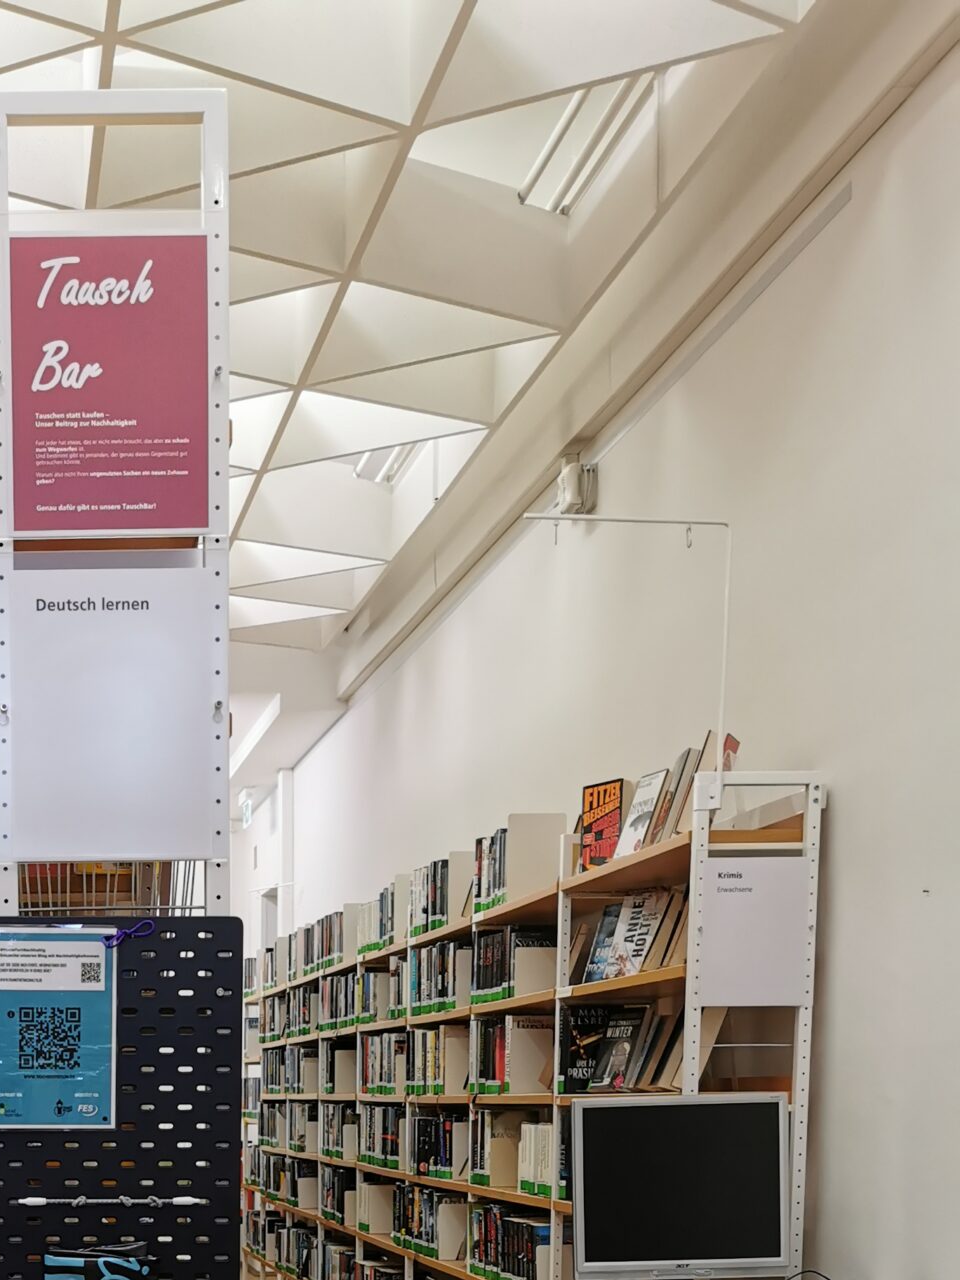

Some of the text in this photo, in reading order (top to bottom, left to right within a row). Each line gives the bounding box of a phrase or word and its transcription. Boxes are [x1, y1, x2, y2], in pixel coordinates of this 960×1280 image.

[37, 256, 153, 308] Tausch
[31, 339, 103, 392] Bar
[55, 420, 78, 428] Beitrag
[91, 419, 137, 427] Nachhaltigkeit
[58, 503, 75, 511] dafür
[77, 503, 90, 512] gibt
[36, 597, 150, 611] Deutsch lernen
[718, 871, 743, 879] Krimis
[624, 899, 646, 944] ANNE
[632, 922, 652, 958] HOLT
[606, 1026, 633, 1039] WINTER
[77, 1104, 94, 1112] FES
